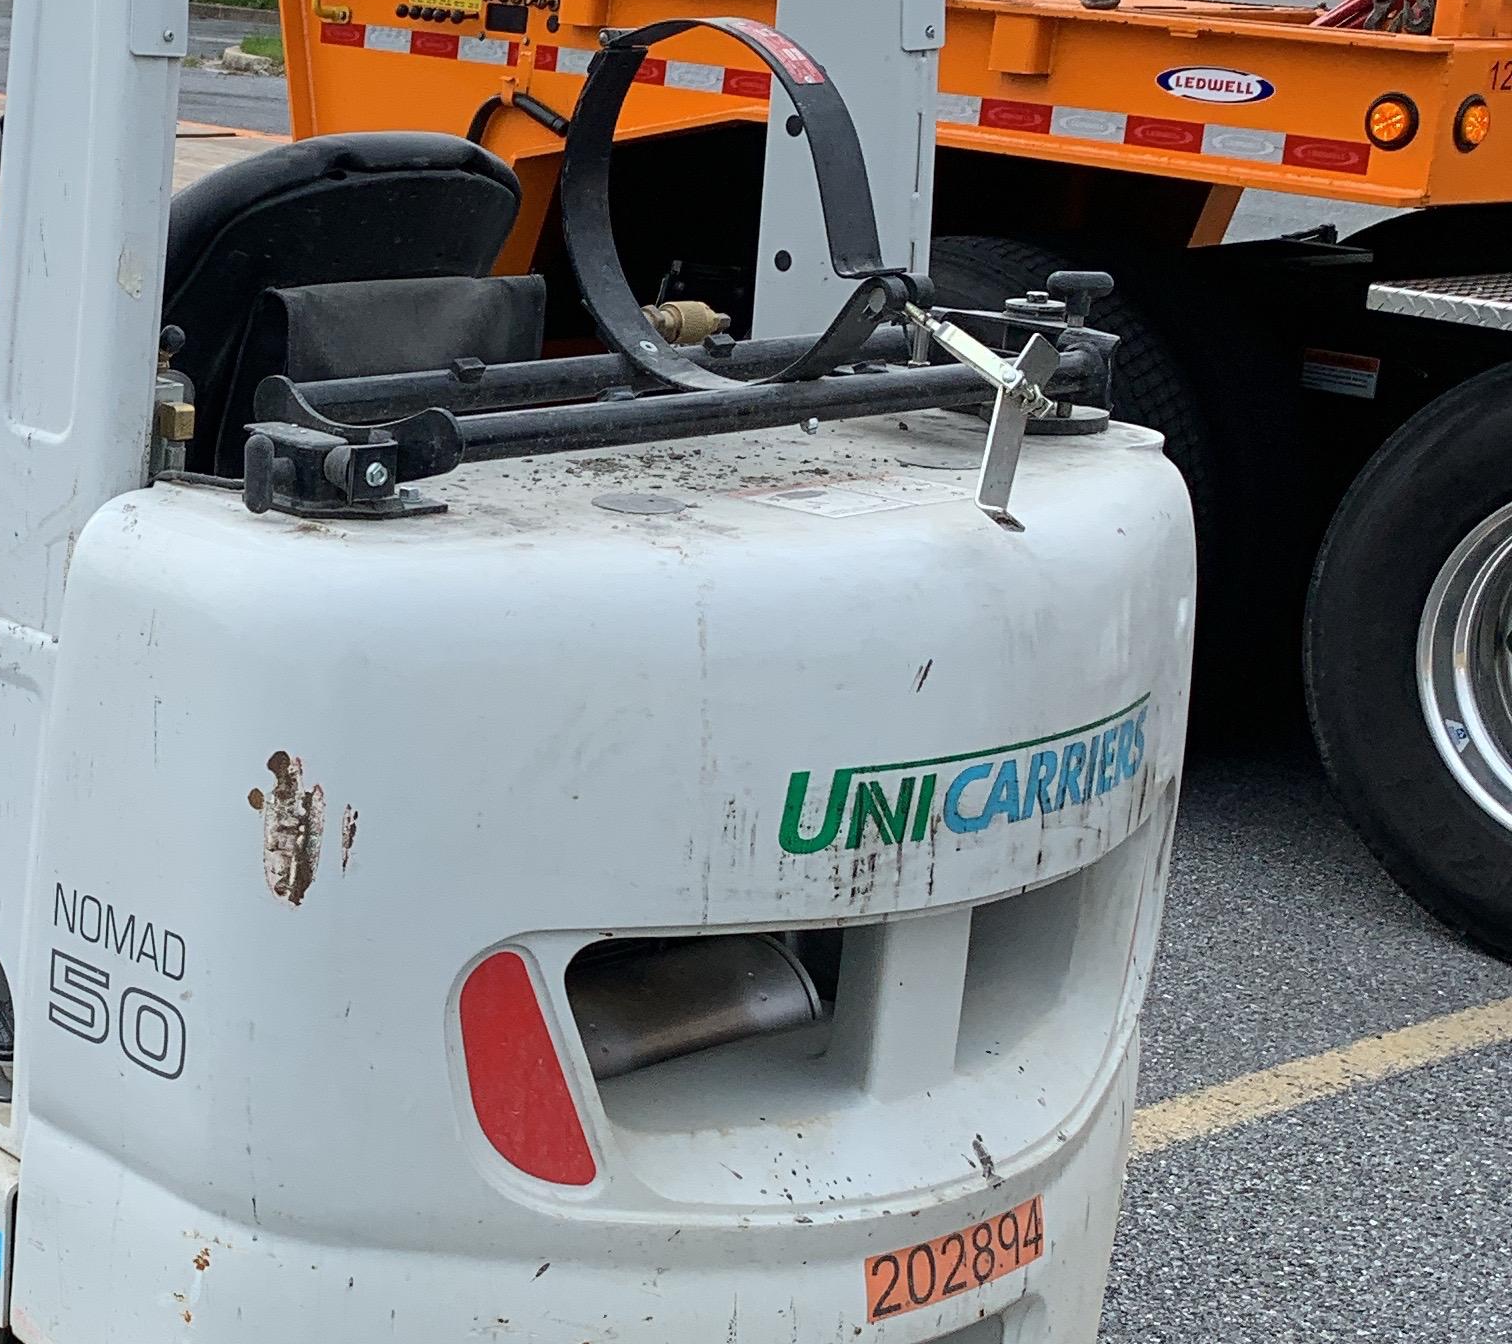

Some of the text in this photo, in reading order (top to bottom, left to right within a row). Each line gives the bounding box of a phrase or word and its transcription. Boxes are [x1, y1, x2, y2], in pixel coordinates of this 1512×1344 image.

[1175, 75, 1254, 95] LEDWELL
[53, 882, 187, 982] NOMAD
[48, 948, 187, 1081] 50
[870, 1197, 1043, 1318] 202894
